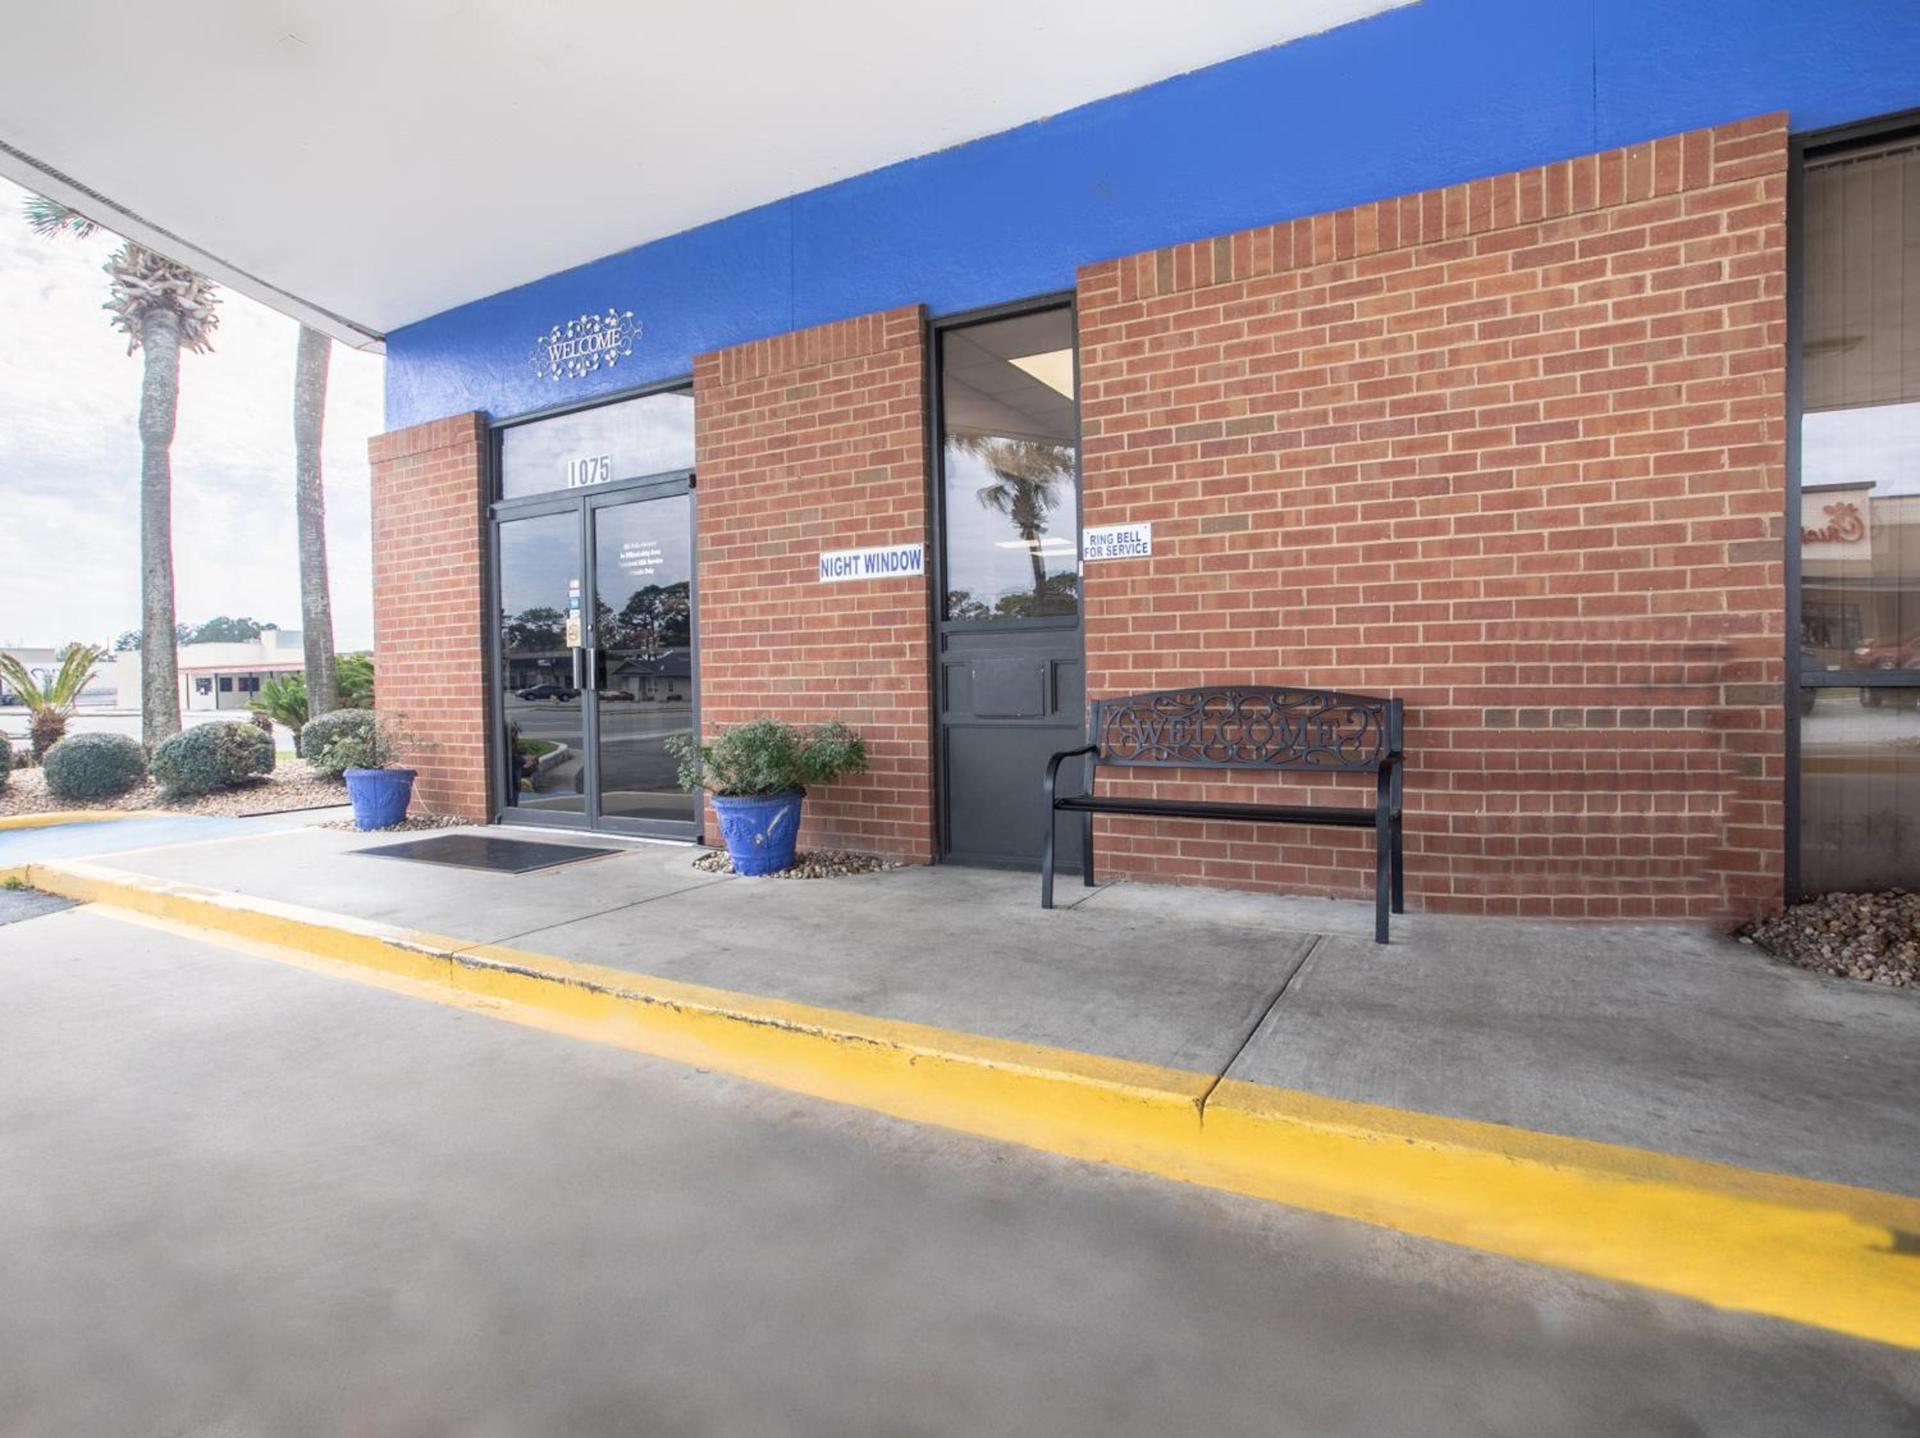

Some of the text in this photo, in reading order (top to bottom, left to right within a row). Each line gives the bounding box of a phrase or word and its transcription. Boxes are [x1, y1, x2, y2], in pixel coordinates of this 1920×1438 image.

[549, 328, 622, 362] WELCOME
[570, 456, 610, 487] 1075
[1084, 542, 1149, 558] FOR SERVICE
[1089, 531, 1142, 546] RING BELL
[821, 549, 922, 577] NIGHT WINDOW
[1134, 715, 1340, 748] WELCOME
